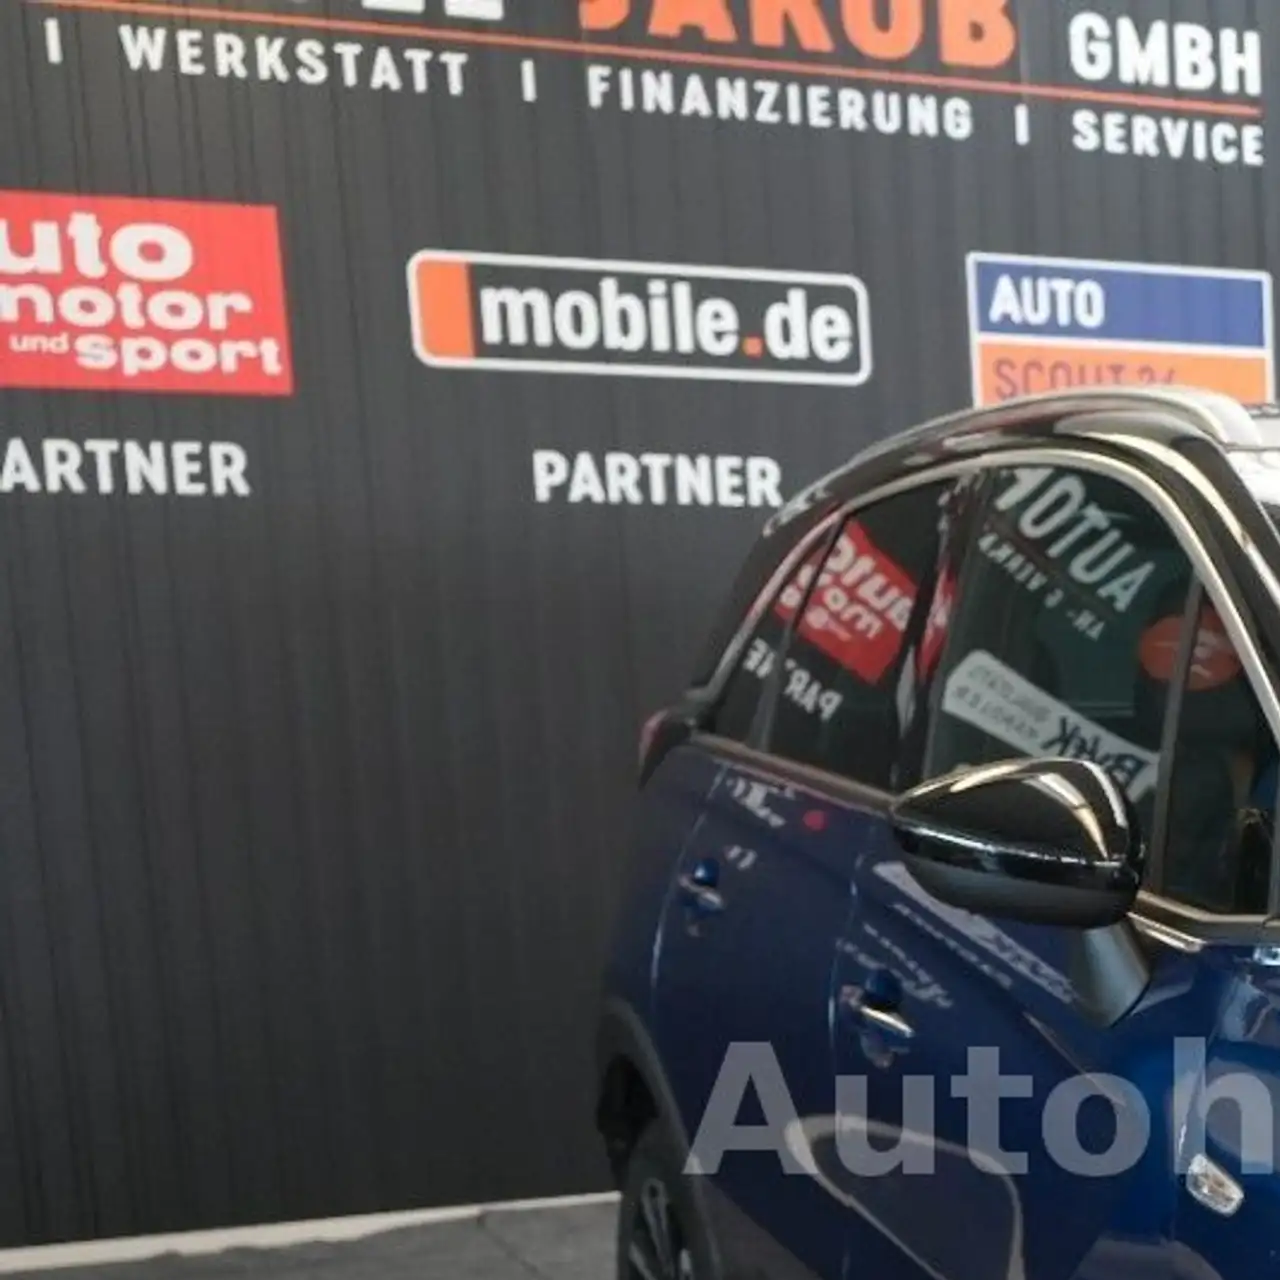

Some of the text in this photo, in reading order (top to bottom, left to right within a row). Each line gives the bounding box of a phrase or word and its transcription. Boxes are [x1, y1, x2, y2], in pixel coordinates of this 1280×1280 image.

[1068, 11, 1262, 97] GMBH
[118, 24, 470, 96] WERKSTATT
[586, 63, 973, 141] FINANZIERUNG
[1071, 108, 1265, 167] SERVICE
[479, 276, 853, 363] mobile.de
[987, 273, 1107, 330] AUTO
[9, 331, 283, 378] und sport
[532, 448, 784, 509] PARTNER
